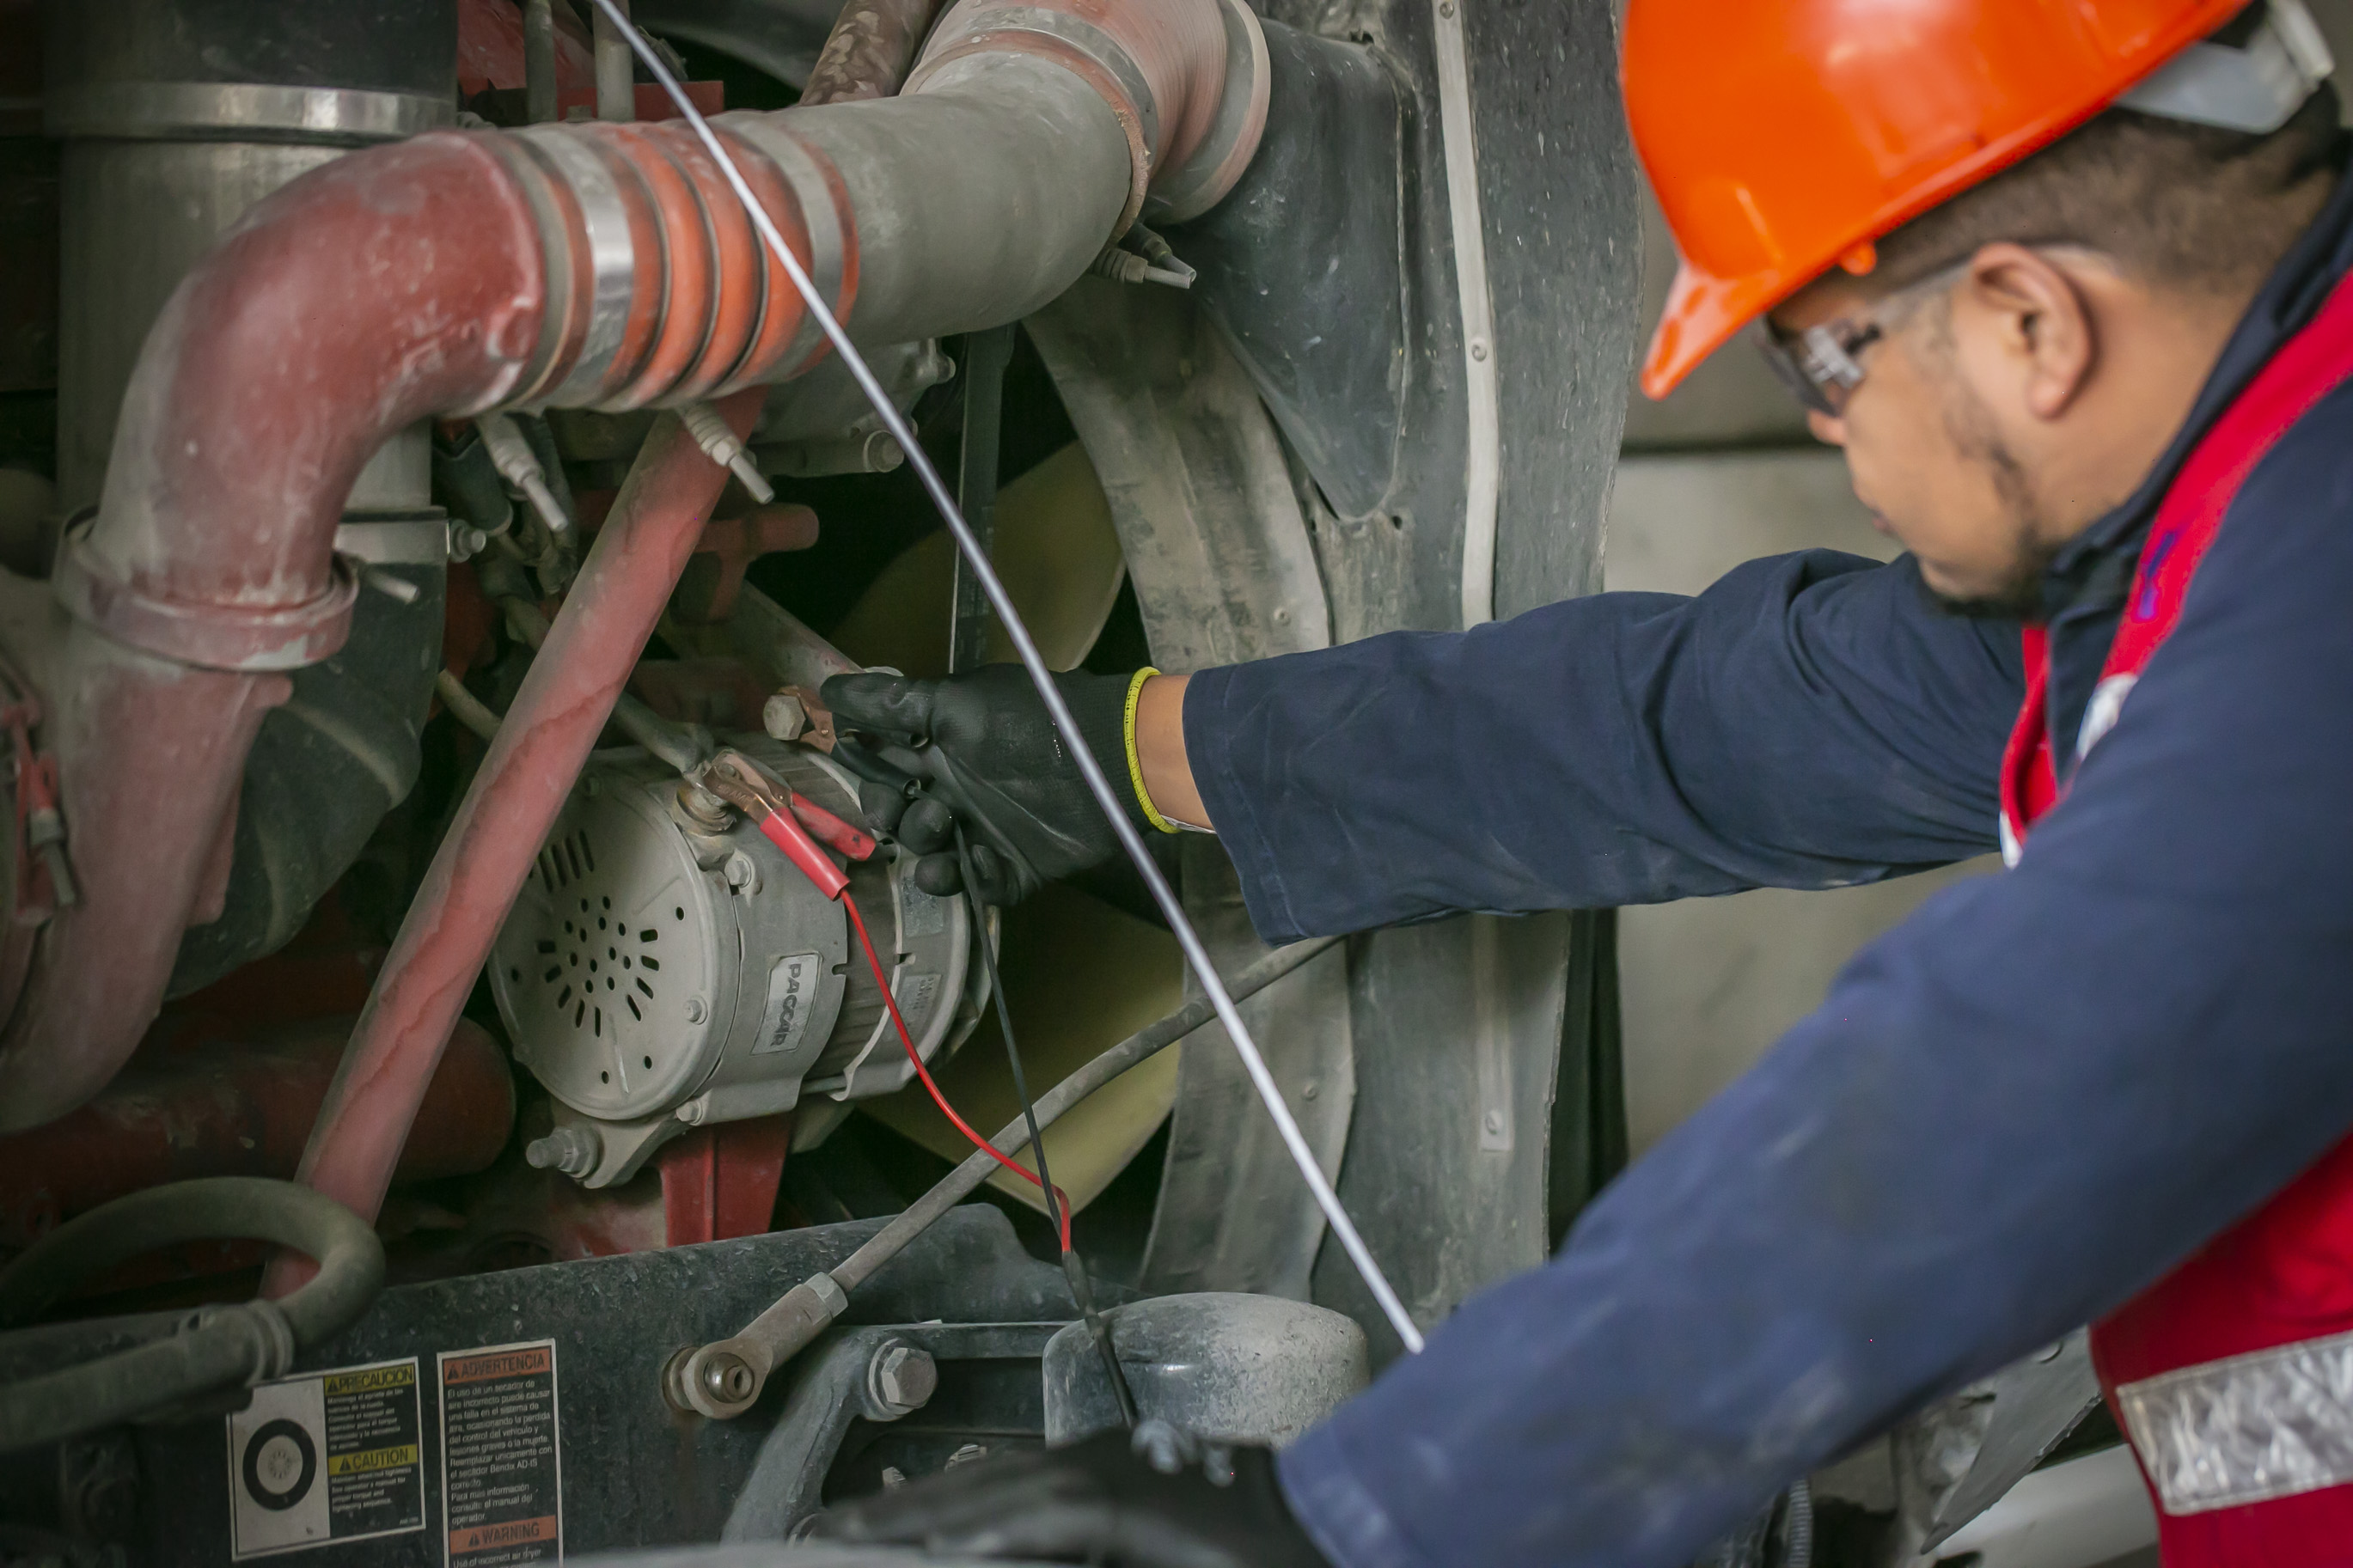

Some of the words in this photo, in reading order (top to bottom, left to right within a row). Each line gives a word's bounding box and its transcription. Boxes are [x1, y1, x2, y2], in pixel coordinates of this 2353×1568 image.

[770, 964, 801, 1046] PACCAR
[461, 1353, 544, 1377] ADVERTENCIA
[526, 1380, 535, 1388] de
[464, 1396, 499, 1408] incorrecto
[502, 1393, 524, 1404] puede
[527, 1390, 550, 1400] causar
[492, 1406, 498, 1415] el
[500, 1403, 527, 1413] sistema
[467, 1418, 512, 1431] ocasionando
[449, 1436, 460, 1444] del
[462, 1431, 487, 1442] control
[490, 1430, 501, 1438] del
[353, 1448, 407, 1469] CAUTION
[450, 1455, 492, 1467] Reemplazar
[491, 1463, 515, 1473] Bendix
[485, 1499, 491, 1509] el
[493, 1494, 519, 1506] manual
[522, 1493, 532, 1503] del
[483, 1522, 540, 1544] WARNING
[454, 1559, 468, 1568] Use
[469, 1557, 476, 1566] of
[479, 1553, 510, 1565] incorrect
[523, 1547, 541, 1560] dryer
